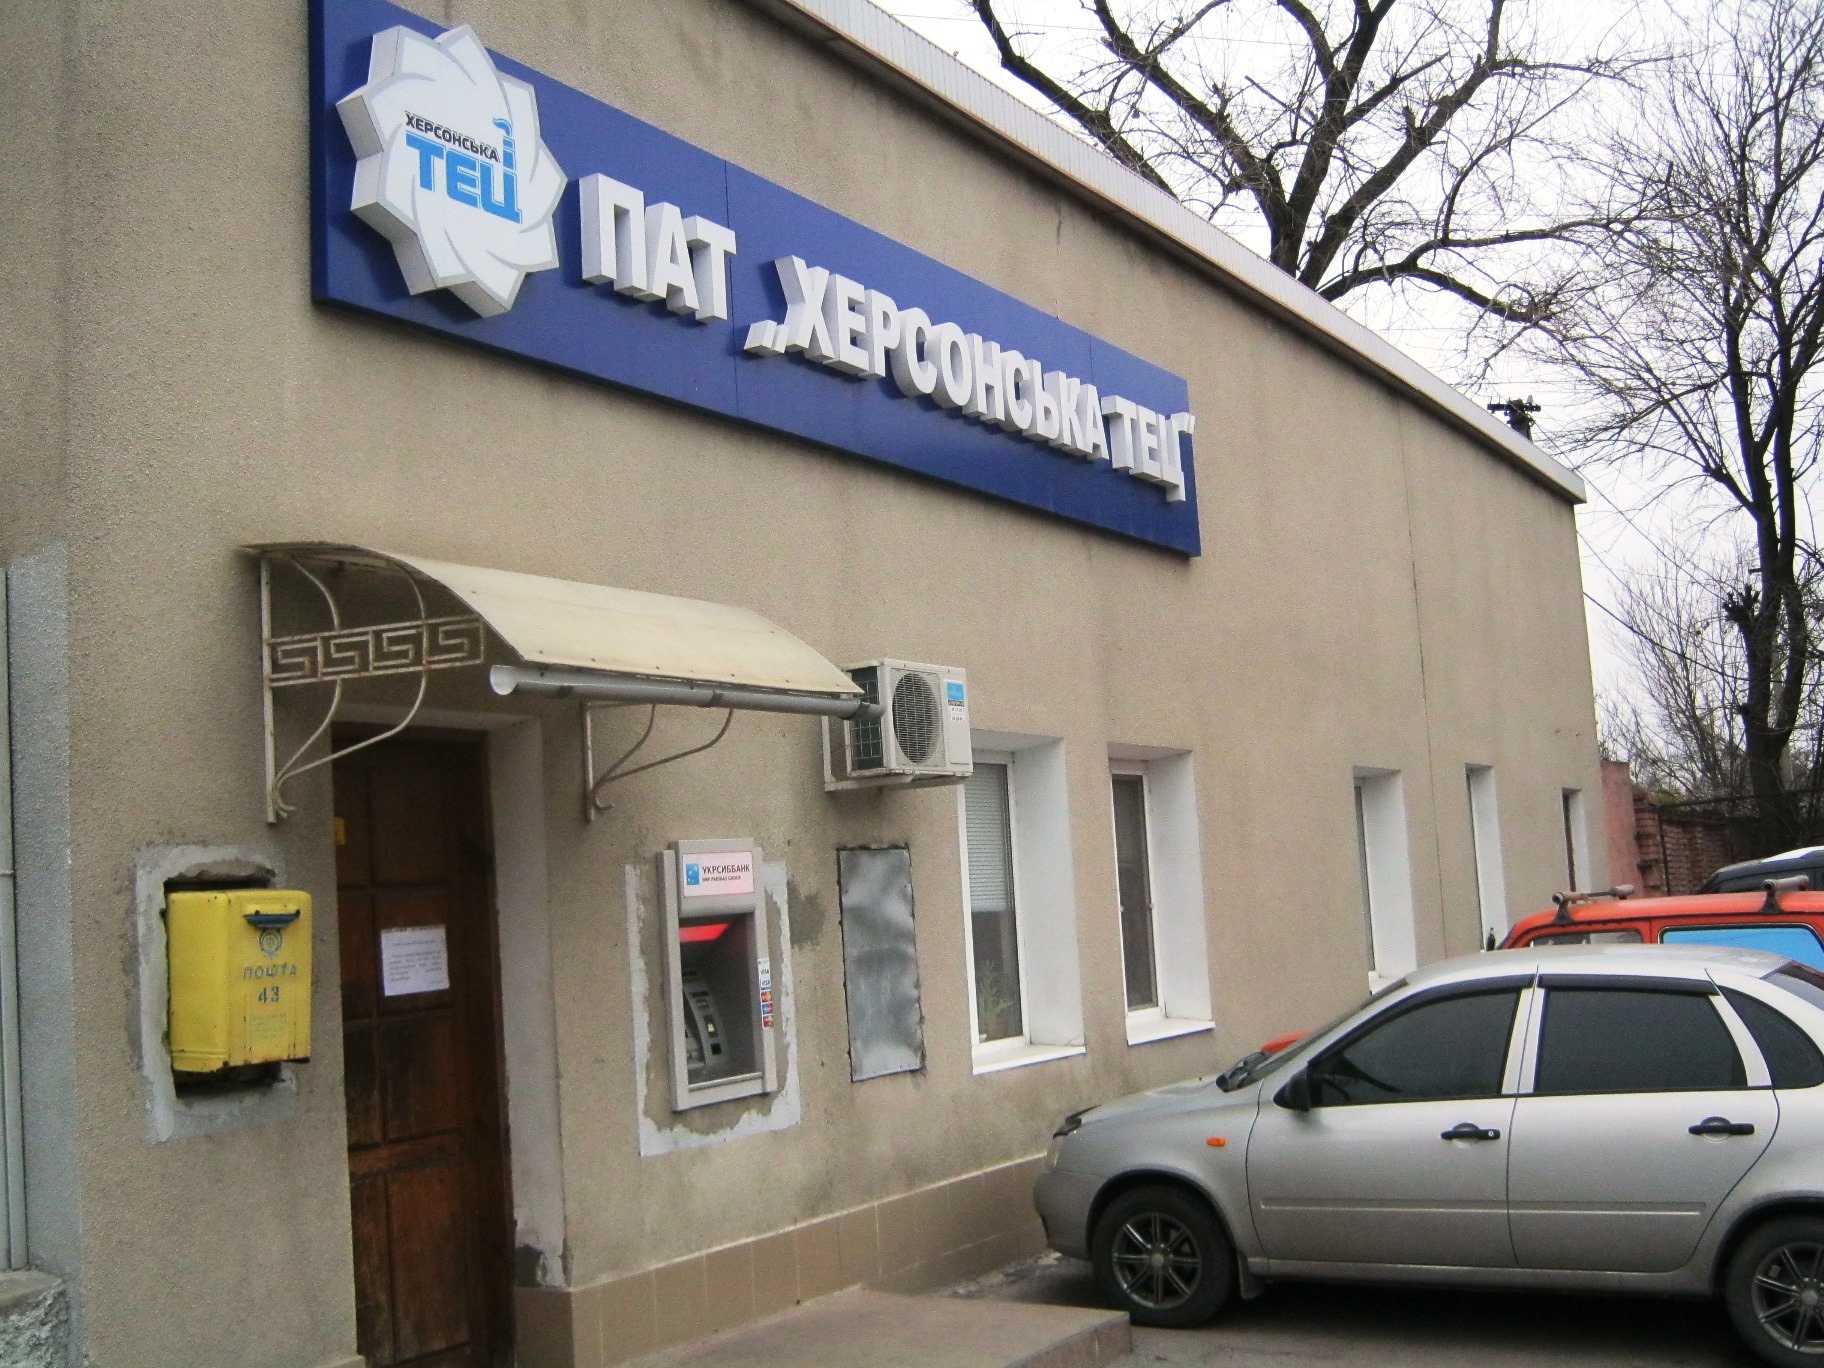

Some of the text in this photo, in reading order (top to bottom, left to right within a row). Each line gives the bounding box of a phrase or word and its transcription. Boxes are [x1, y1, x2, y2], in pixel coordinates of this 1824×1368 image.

[404, 110, 501, 164] ХЕРСОНСЬКА
[405, 129, 523, 225] ТЕЦ
[579, 172, 736, 324] ПАТ
[702, 864, 751, 874] УКРСИББАНК
[258, 986, 280, 1004] 43
